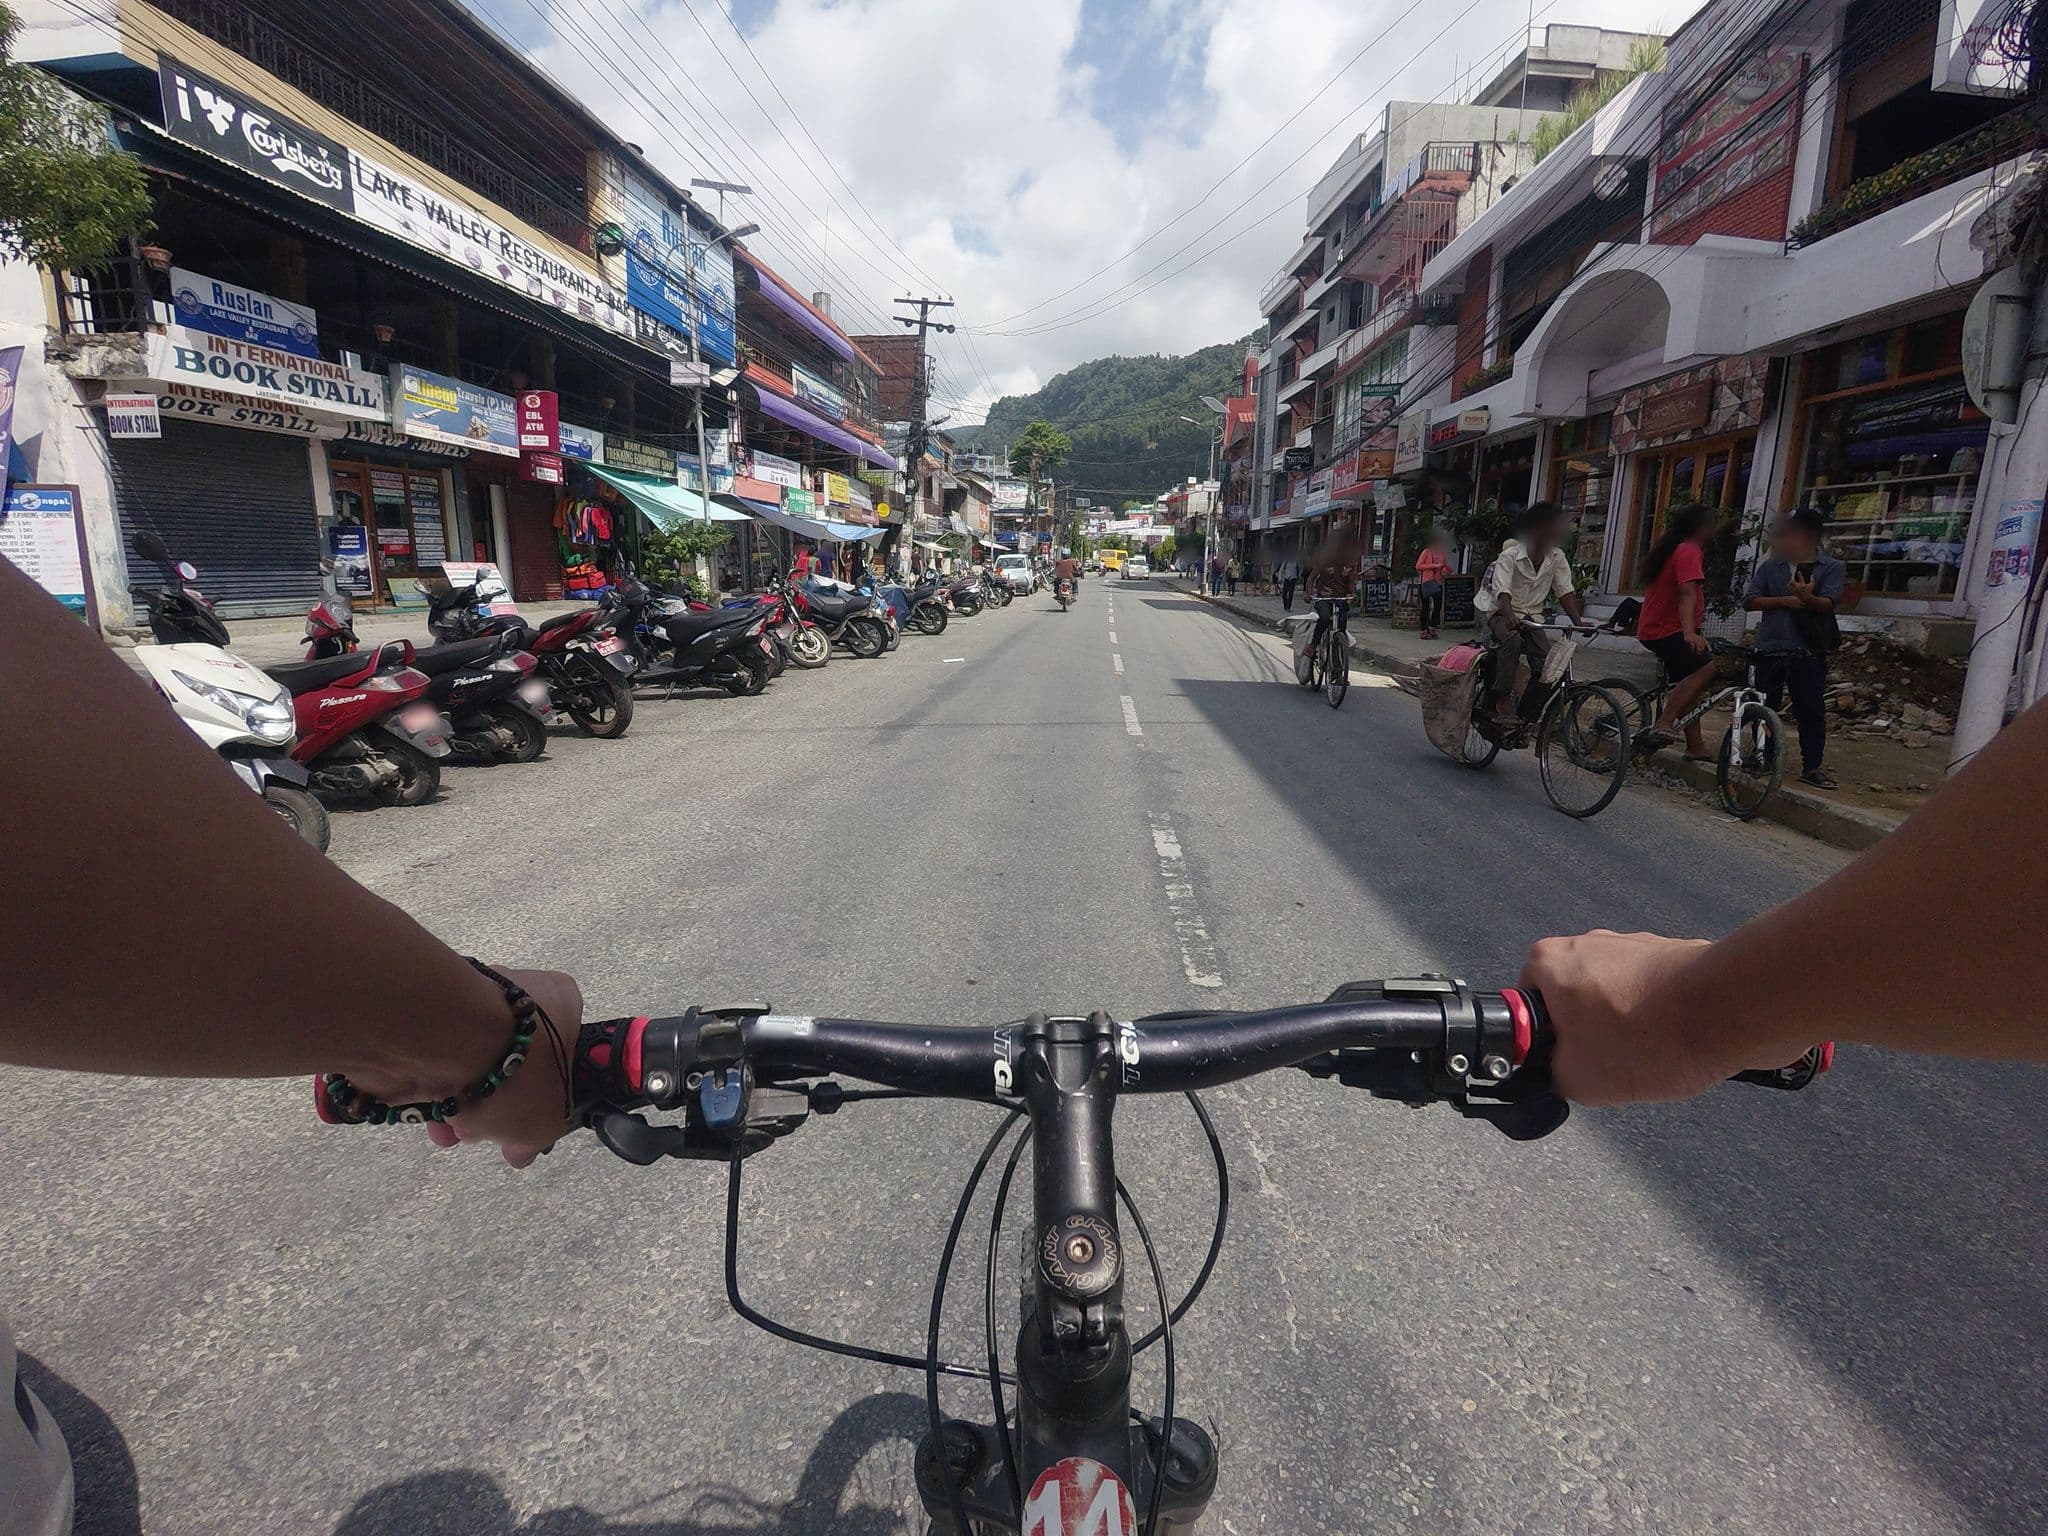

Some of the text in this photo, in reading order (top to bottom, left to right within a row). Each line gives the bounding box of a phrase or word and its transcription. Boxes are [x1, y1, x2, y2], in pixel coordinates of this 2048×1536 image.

[241, 110, 343, 190] Carlsberg
[354, 154, 415, 212] LAKE
[422, 197, 492, 250] VALLEY
[499, 230, 593, 299] RESTAURANT
[594, 281, 604, 304] &
[608, 291, 631, 318] BAR
[209, 307, 227, 319] LAKE
[228, 311, 250, 325] VALLEY
[211, 282, 274, 320] Ruslan
[206, 335, 354, 384] INTERNATIONAL
[172, 345, 282, 392] BOOK
[287, 373, 378, 409] STALL
[106, 399, 156, 408] INTERNATIONAL
[146, 392, 319, 433] OOK STALL
[167, 382, 304, 415] INTERNATIONAL
[456, 386, 485, 405] Travels
[487, 393, 499, 412] (P)
[501, 400, 516, 414] Ltd.
[111, 414, 159, 434] BOOK STALL
[525, 411, 543, 421] EBL
[525, 422, 545, 432] ATM
[1367, 583, 1387, 595] PHO
[453, 673, 493, 689] Pleasure
[319, 691, 367, 710] Pleasure
[1044, 1225, 1097, 1289] GIANT
[1065, 1215, 1118, 1276] GIANT
